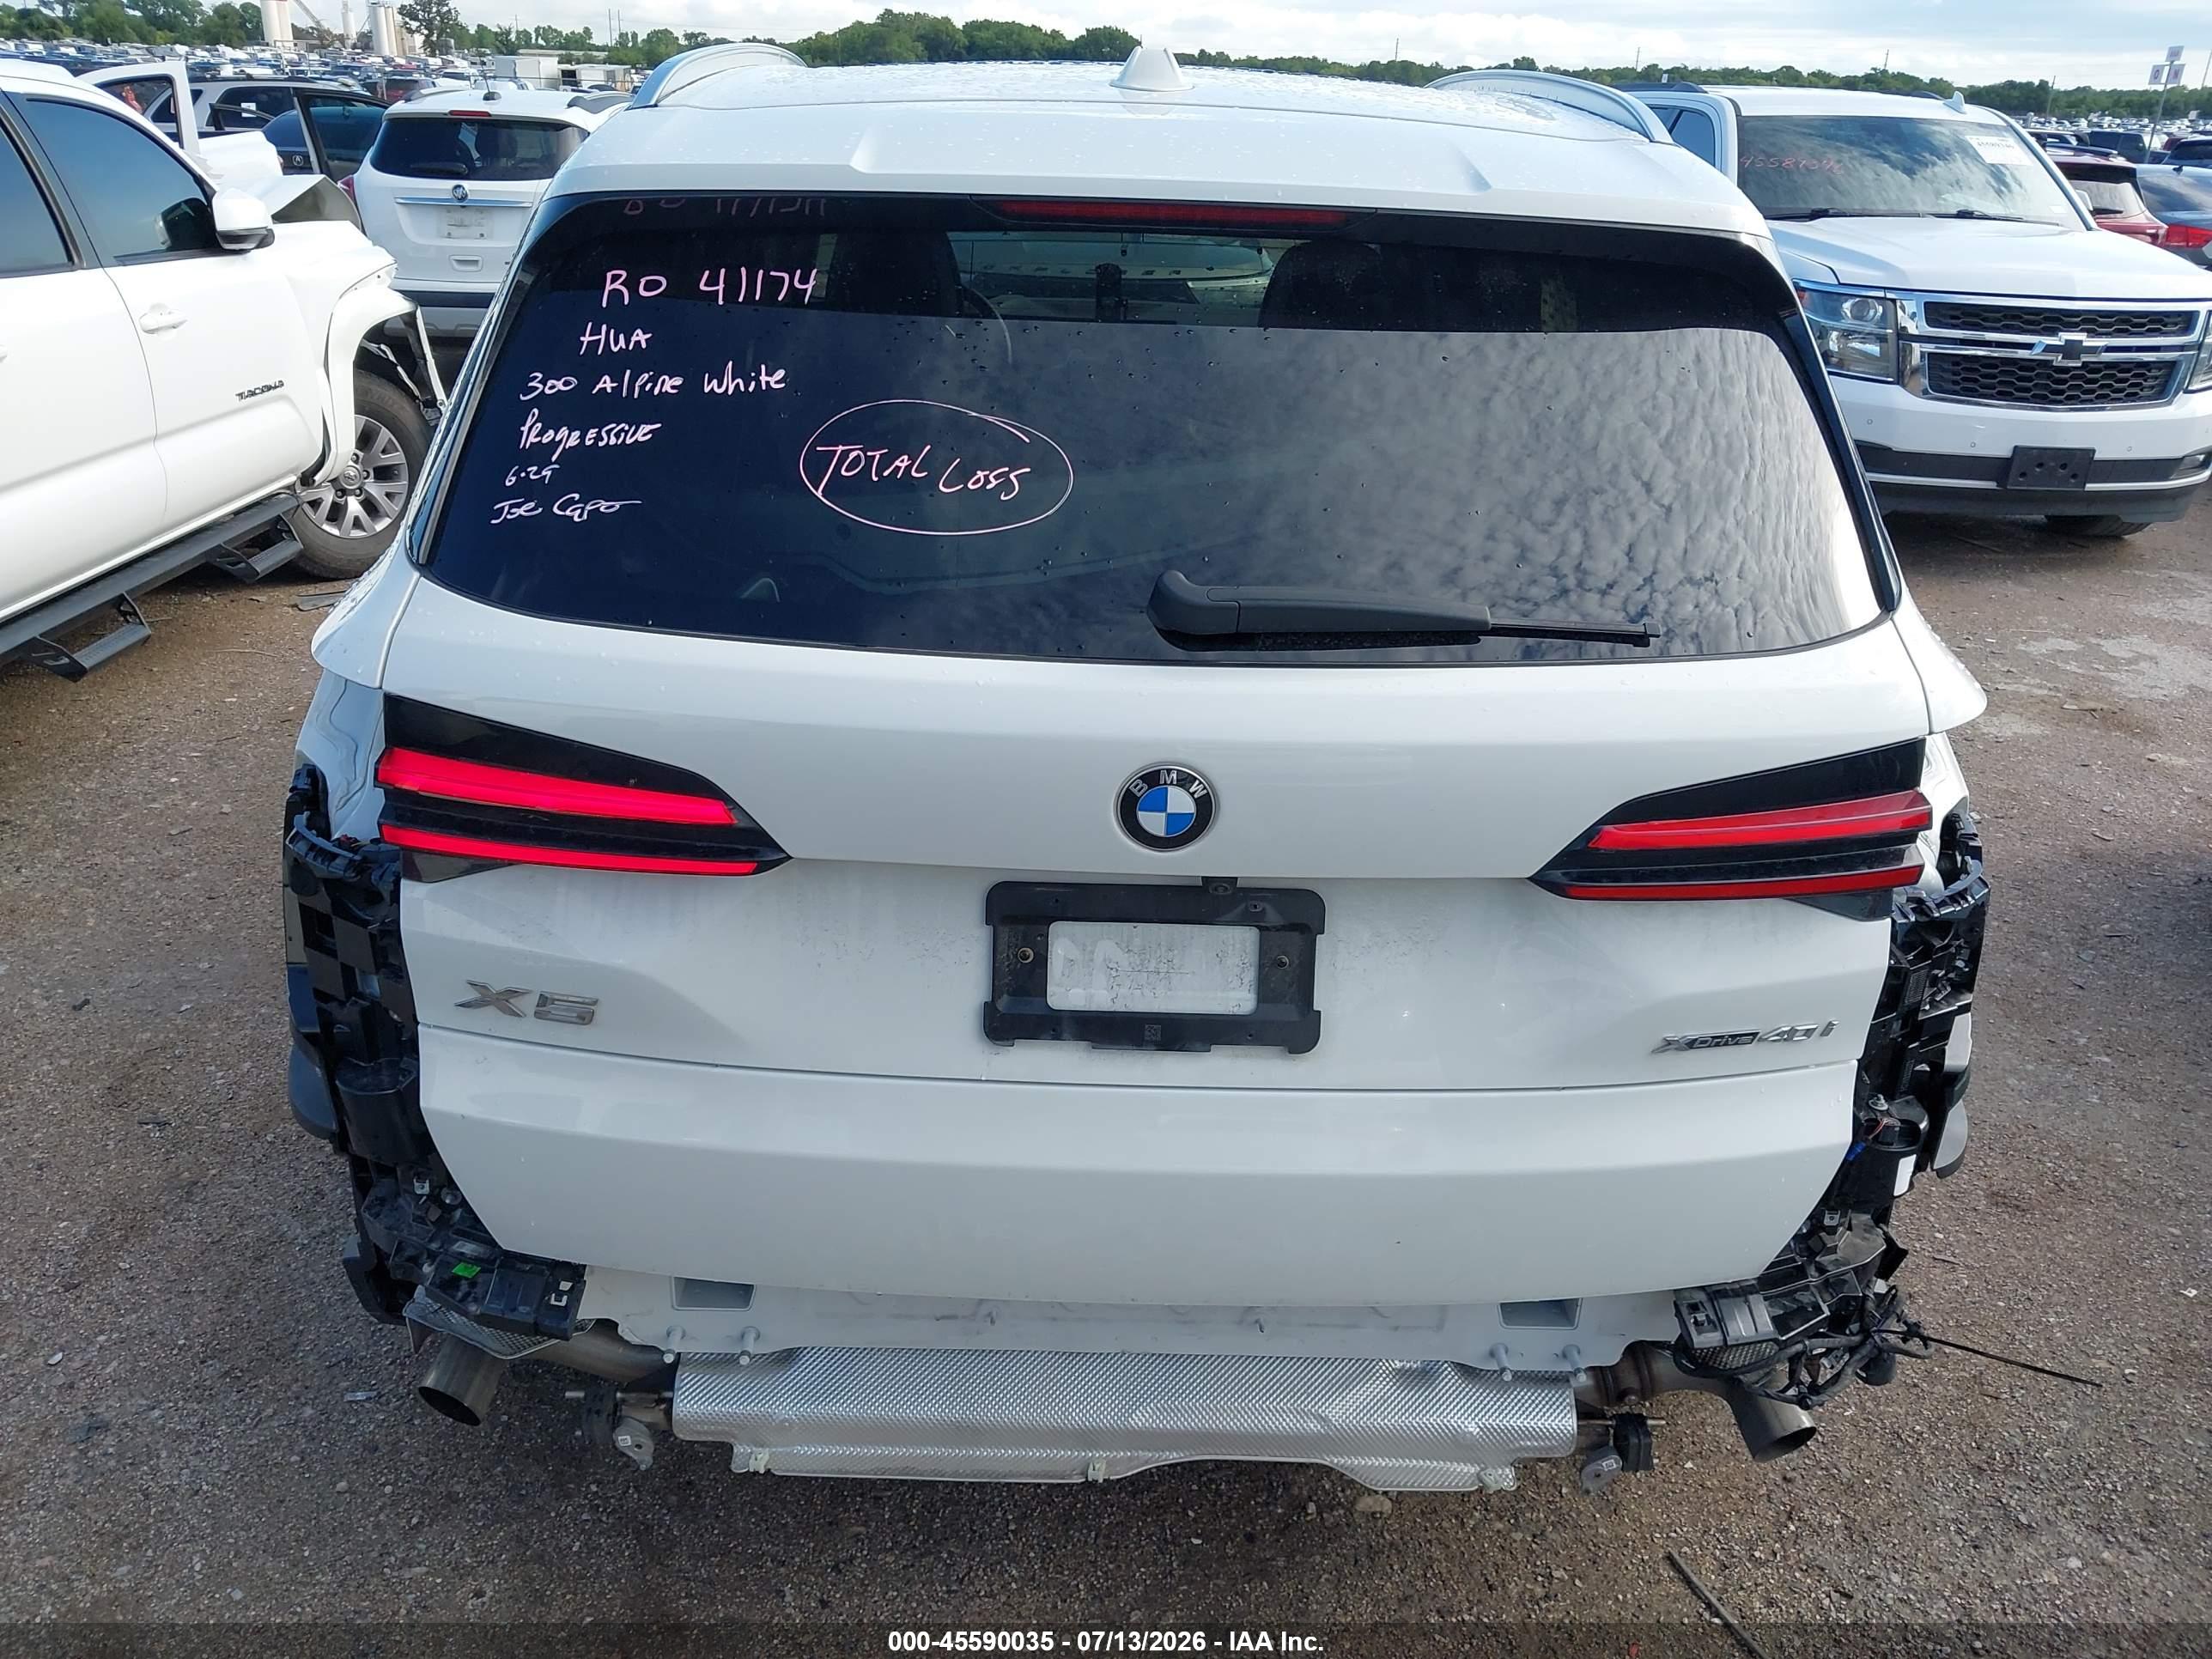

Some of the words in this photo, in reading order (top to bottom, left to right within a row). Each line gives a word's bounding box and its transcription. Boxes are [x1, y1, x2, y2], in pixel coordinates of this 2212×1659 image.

[601, 269, 667, 308] RO
[699, 266, 817, 306] 41174
[579, 321, 653, 356] HUA
[520, 371, 578, 401] 300
[816, 444, 931, 495] TOTAL
[1128, 769, 1208, 799] BMW
[454, 979, 600, 1025] X5
